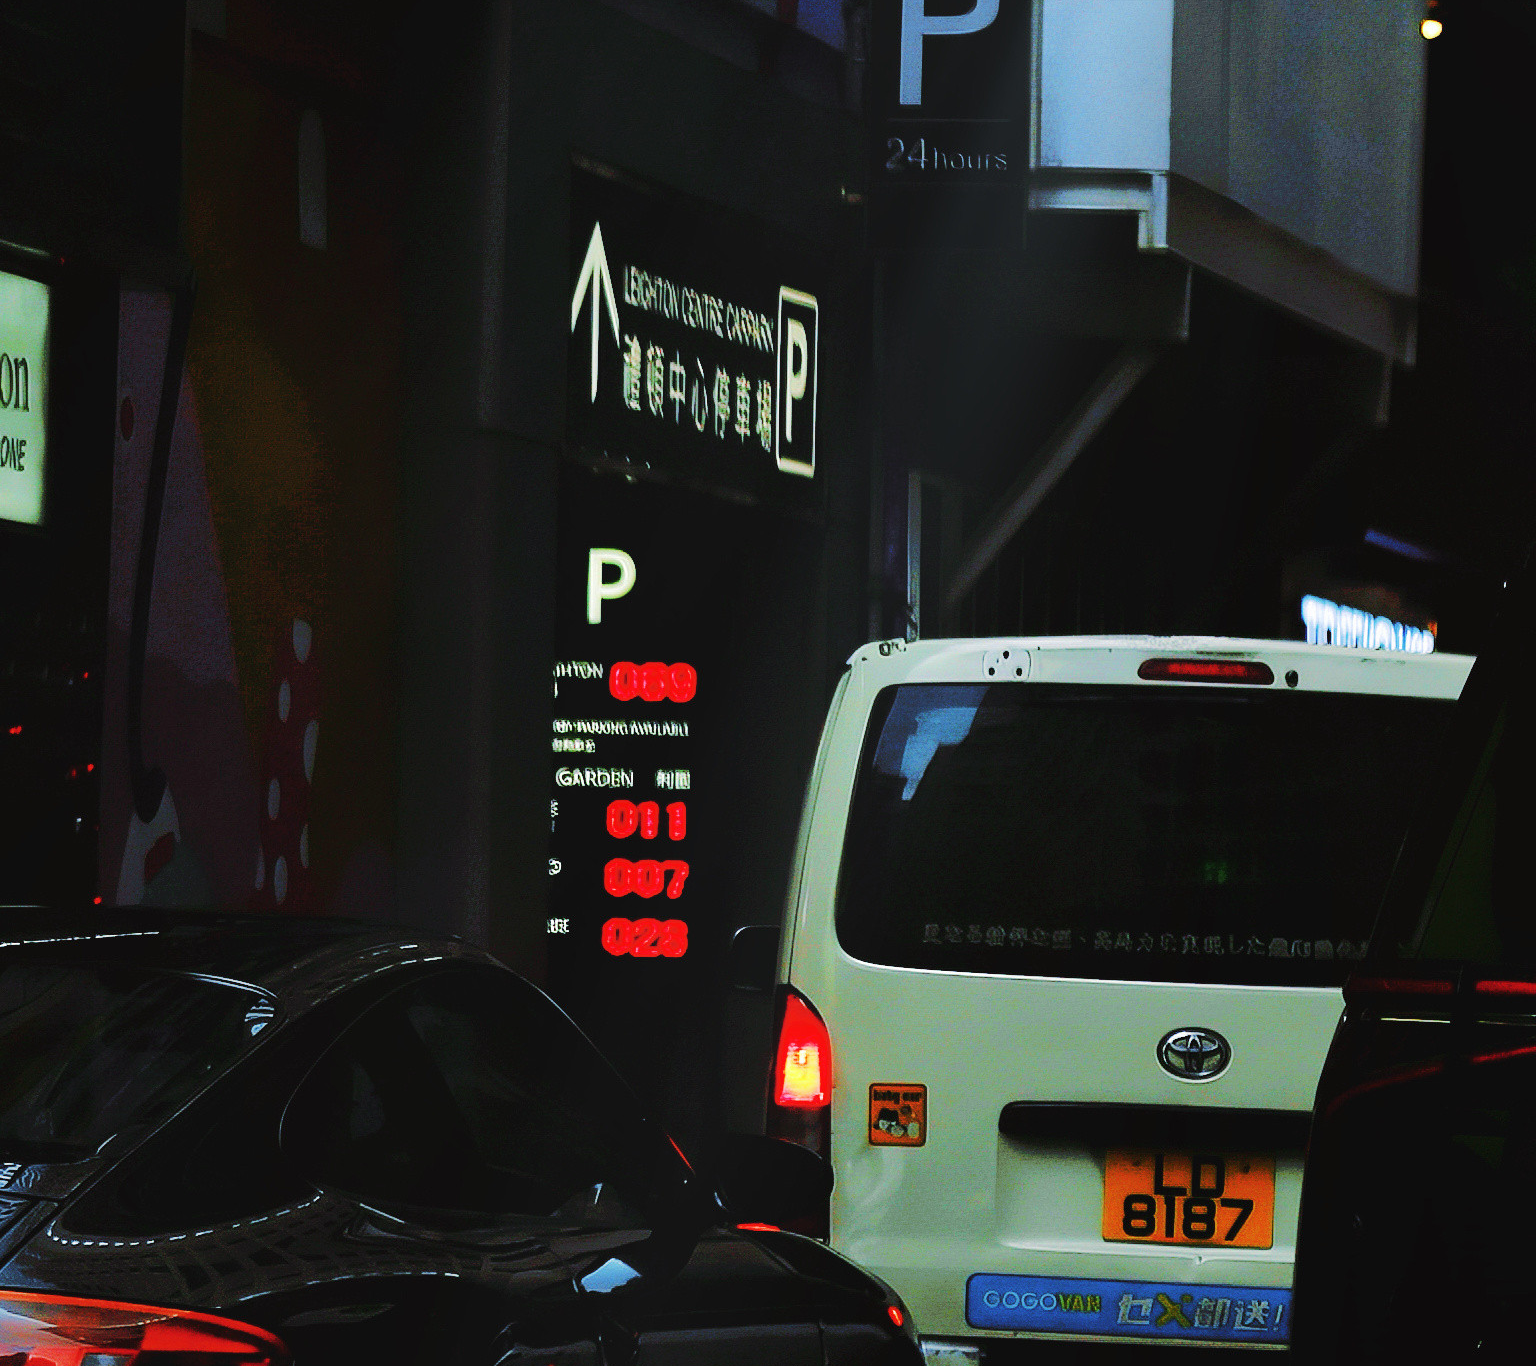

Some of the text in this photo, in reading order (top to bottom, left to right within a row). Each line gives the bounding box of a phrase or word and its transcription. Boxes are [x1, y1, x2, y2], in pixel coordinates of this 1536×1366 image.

[624, 264, 679, 321] LEIGHTON
[785, 317, 808, 443] P
[587, 548, 636, 624] P
[555, 767, 634, 788] GARDEN
[606, 799, 686, 841] 011
[604, 857, 690, 899] 007
[1154, 1152, 1226, 1198] LD
[1122, 1193, 1254, 1241] 8187
[983, 1290, 1102, 1313] GOGOVAN
